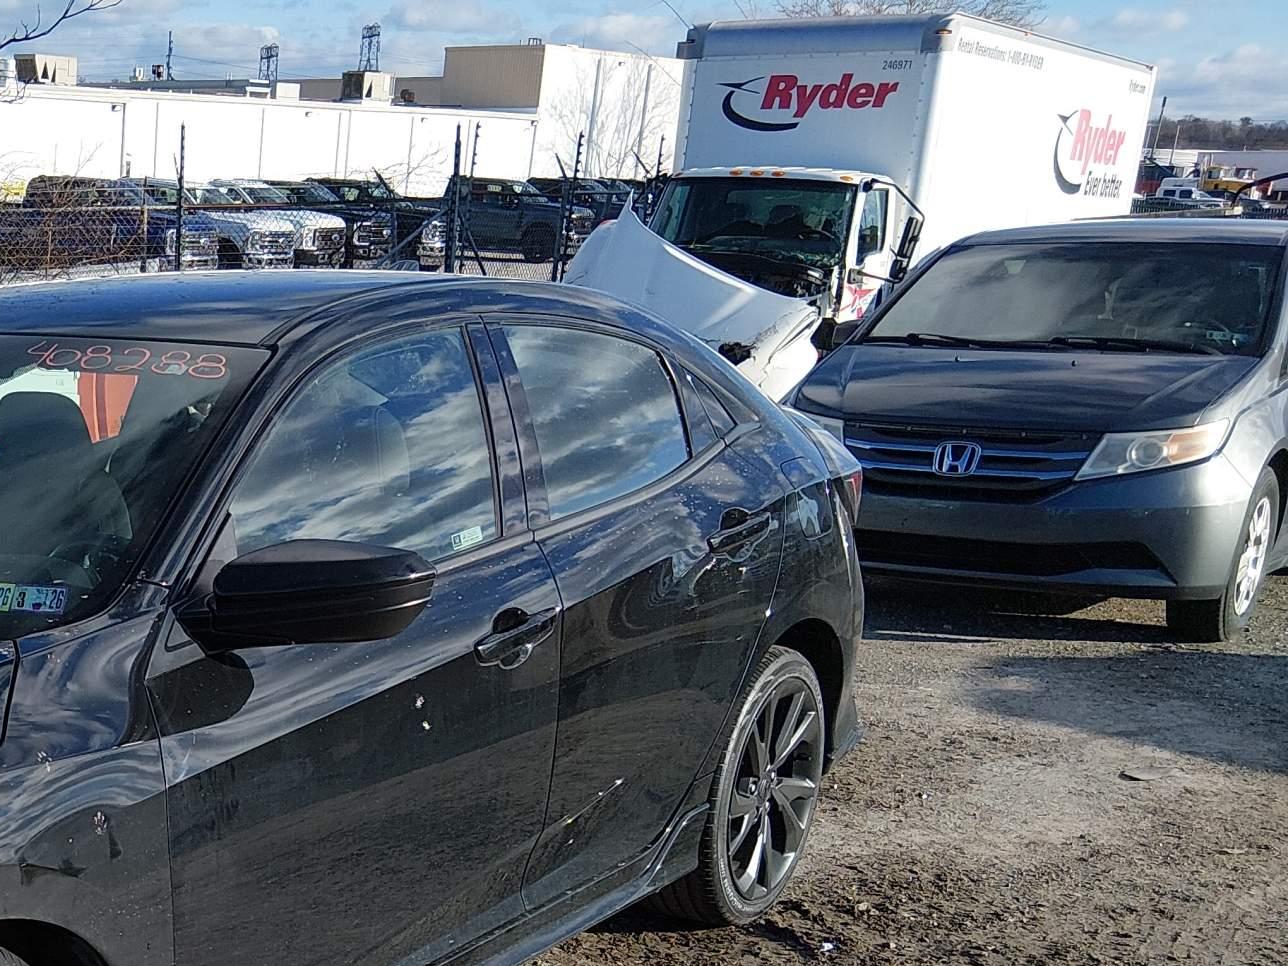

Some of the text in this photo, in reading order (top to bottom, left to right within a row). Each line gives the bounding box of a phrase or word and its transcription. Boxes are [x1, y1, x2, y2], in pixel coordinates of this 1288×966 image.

[957, 36, 976, 55] Rental
[882, 59, 912, 70] 246971
[760, 73, 900, 118] Ryder
[1070, 108, 1126, 175] Ryder
[1083, 170, 1101, 196] Ever
[27, 340, 226, 379] 408288
[16, 591, 27, 608] 3
